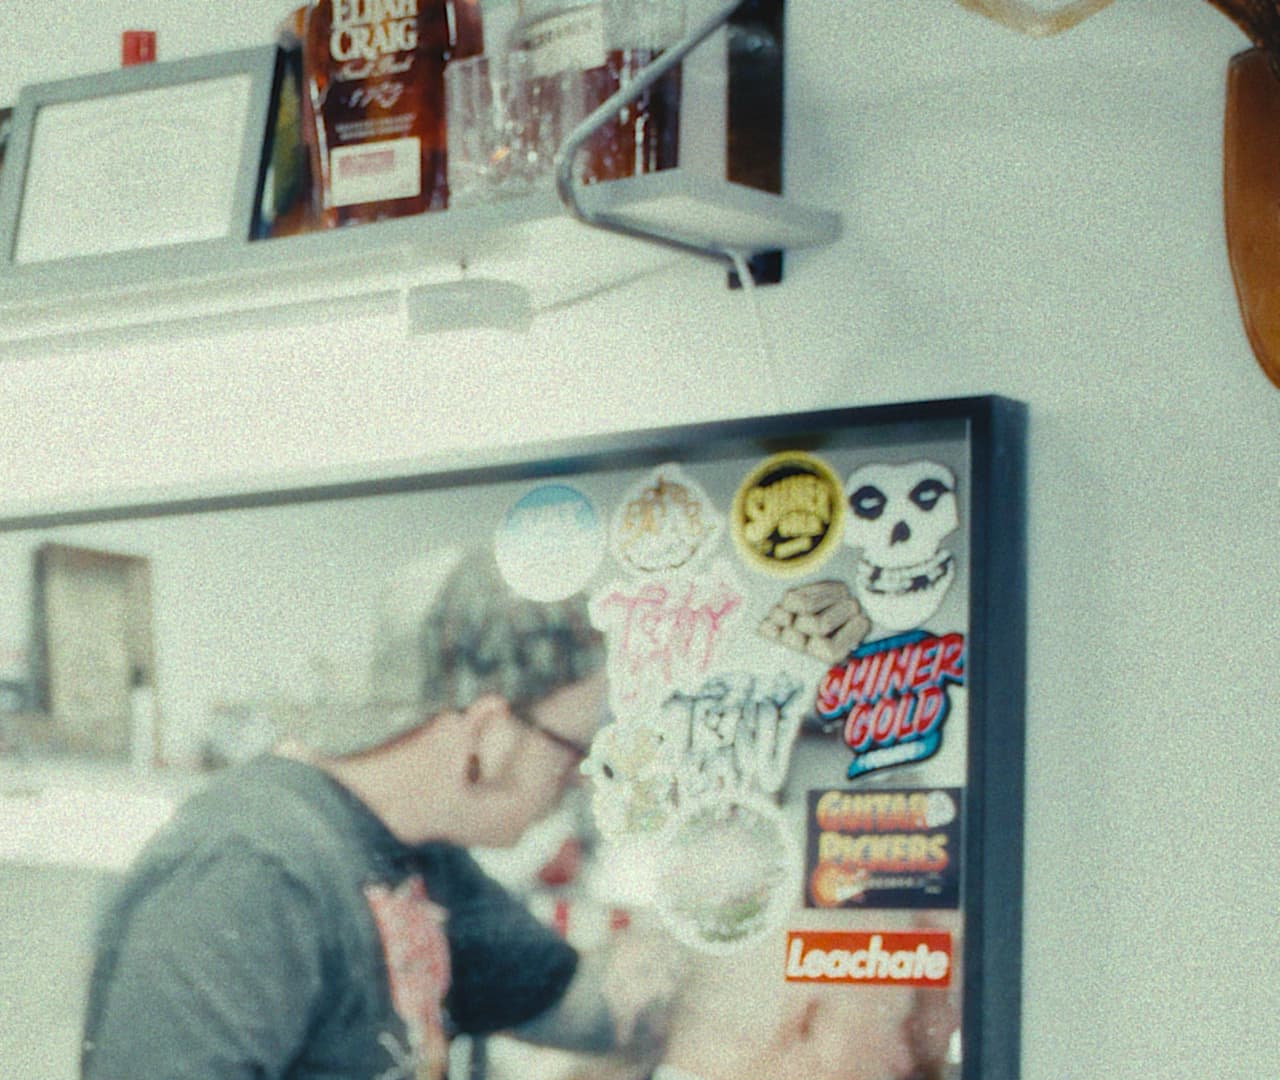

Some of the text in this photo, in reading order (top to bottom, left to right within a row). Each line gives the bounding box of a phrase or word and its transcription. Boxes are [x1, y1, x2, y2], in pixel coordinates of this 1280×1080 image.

[329, 18, 418, 62] CRAIG
[816, 632, 964, 719] SHINER
[844, 684, 946, 752] GOLD
[786, 935, 951, 982] Leachate
